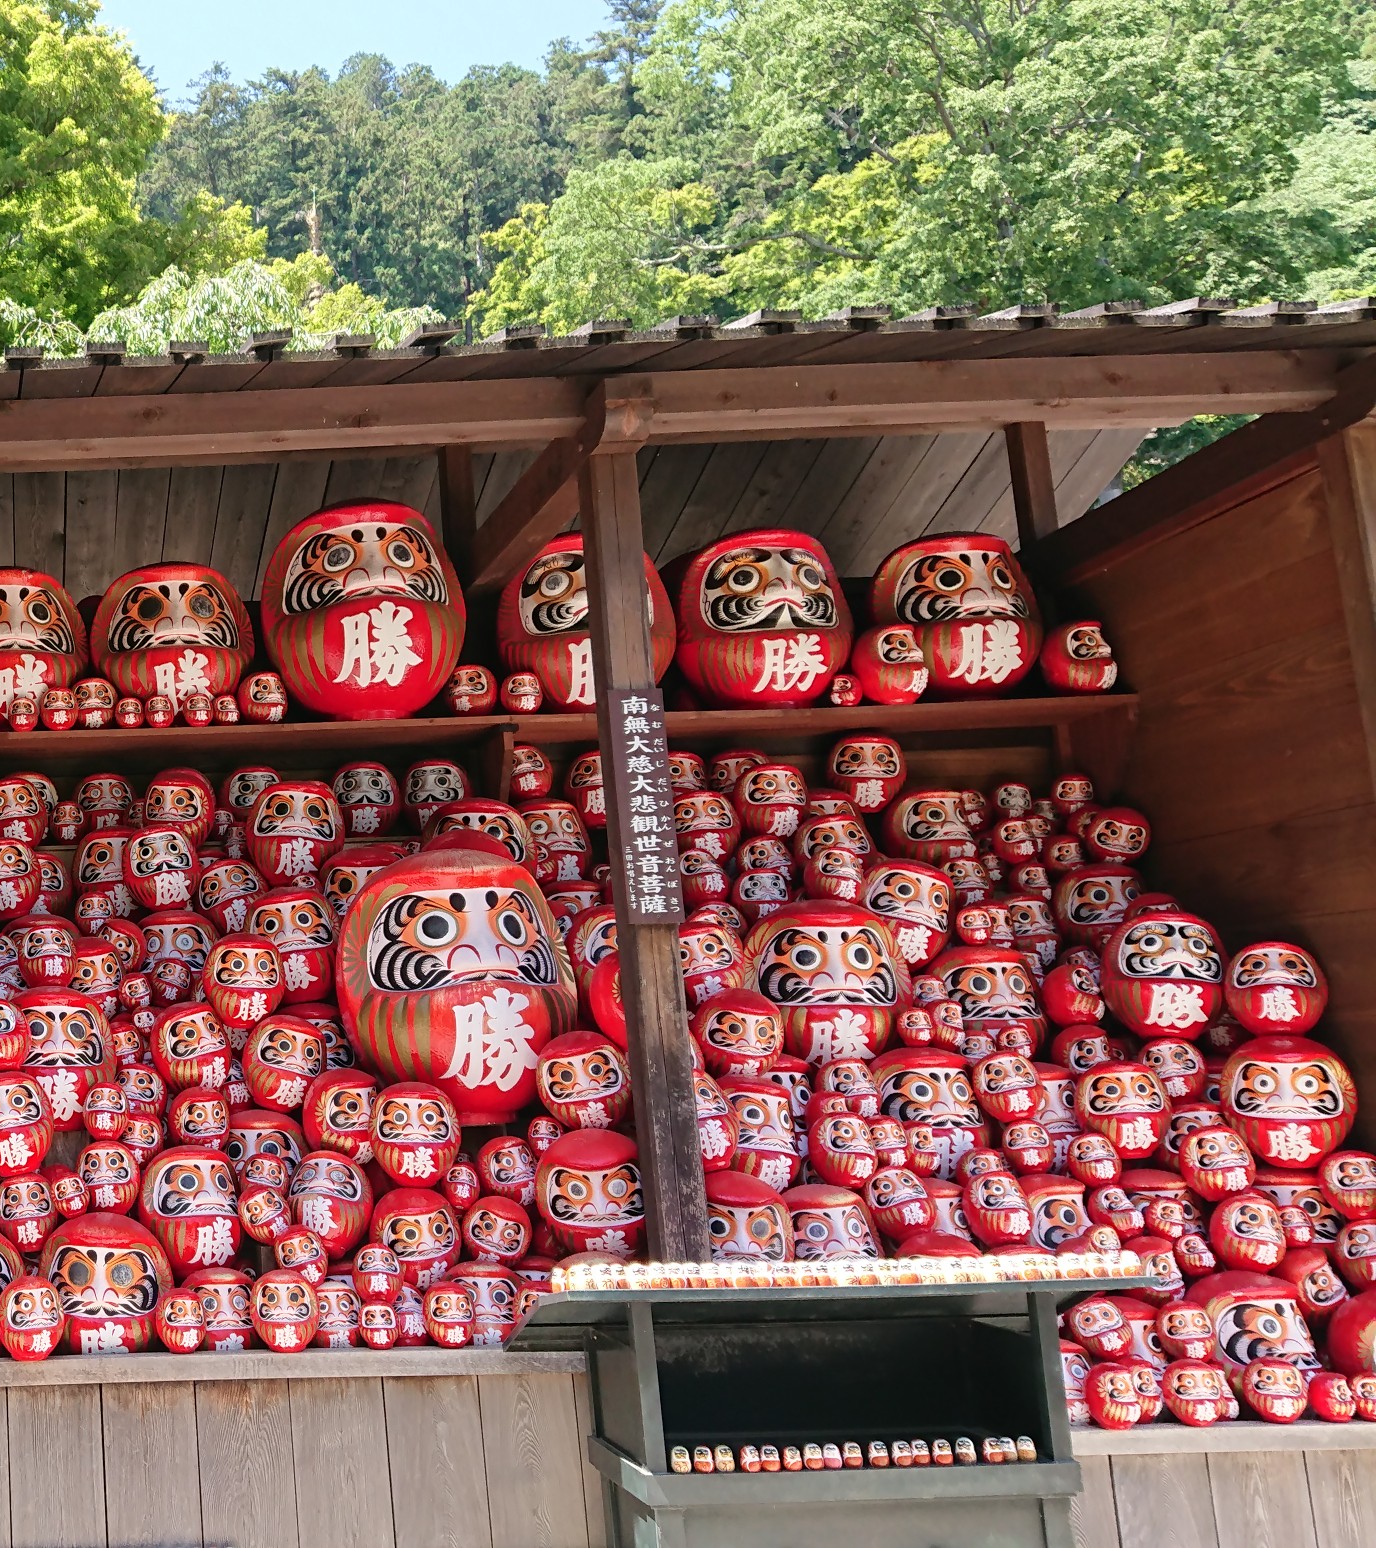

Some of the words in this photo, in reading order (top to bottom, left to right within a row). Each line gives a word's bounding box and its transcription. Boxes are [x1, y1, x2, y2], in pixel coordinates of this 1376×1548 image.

[333, 601, 423, 687] 勝
[949, 619, 1023, 684] 勝
[753, 633, 829, 693] 勝
[905, 667, 928, 694] 勝
[519, 773, 539, 791] 勝
[854, 779, 886, 808] 勝
[620, 695, 669, 914] 南無大慈大悲観世音菩薩
[3, 819, 32, 842] 勝
[351, 807, 381, 834] 勝
[767, 806, 799, 837] 勝
[275, 838, 318, 876] 勝
[695, 832, 726, 860] 勝
[557, 854, 582, 882] 勝
[154, 871, 191, 906] 勝
[704, 873, 725, 892] 勝
[832, 880, 857, 900] 勝
[223, 899, 247, 932] 勝
[897, 925, 932, 964] 勝
[44, 956, 63, 977] 勝
[285, 954, 319, 991] 勝
[234, 992, 269, 1022] 勝
[1144, 983, 1208, 1029] 勝
[1258, 985, 1301, 1022] 勝
[440, 988, 537, 1091] 勝
[202, 1057, 227, 1090] 勝
[36, 1069, 83, 1122] 勝
[228, 1082, 251, 1104] 勝
[269, 1077, 308, 1106] 勝
[1009, 1089, 1034, 1113] 勝
[1166, 1077, 1190, 1098] 勝
[576, 1102, 613, 1129] 勝
[698, 1119, 731, 1159] 勝
[1120, 1117, 1158, 1150] 勝
[1268, 1122, 1321, 1162] 勝
[399, 1146, 437, 1178] 勝
[853, 1158, 873, 1178] 勝
[1095, 1160, 1116, 1179] 勝
[1226, 1167, 1249, 1192] 勝
[95, 1185, 121, 1207] 勝
[302, 1196, 338, 1237] 勝
[902, 1202, 926, 1225] 勝
[1009, 1209, 1030, 1235] 勝
[17, 1221, 42, 1244] 勝
[188, 1216, 235, 1266] 勝
[1253, 1243, 1278, 1265] 勝
[301, 1265, 322, 1284] 勝
[369, 1273, 390, 1292] 勝
[28, 1330, 52, 1352] 勝
[180, 1328, 199, 1348] 勝
[274, 1325, 301, 1348] 勝
[446, 1326, 466, 1343] 勝
[1101, 1332, 1124, 1351] 勝
[1185, 1342, 1206, 1359] 勝
[1196, 1400, 1216, 1422] 勝
